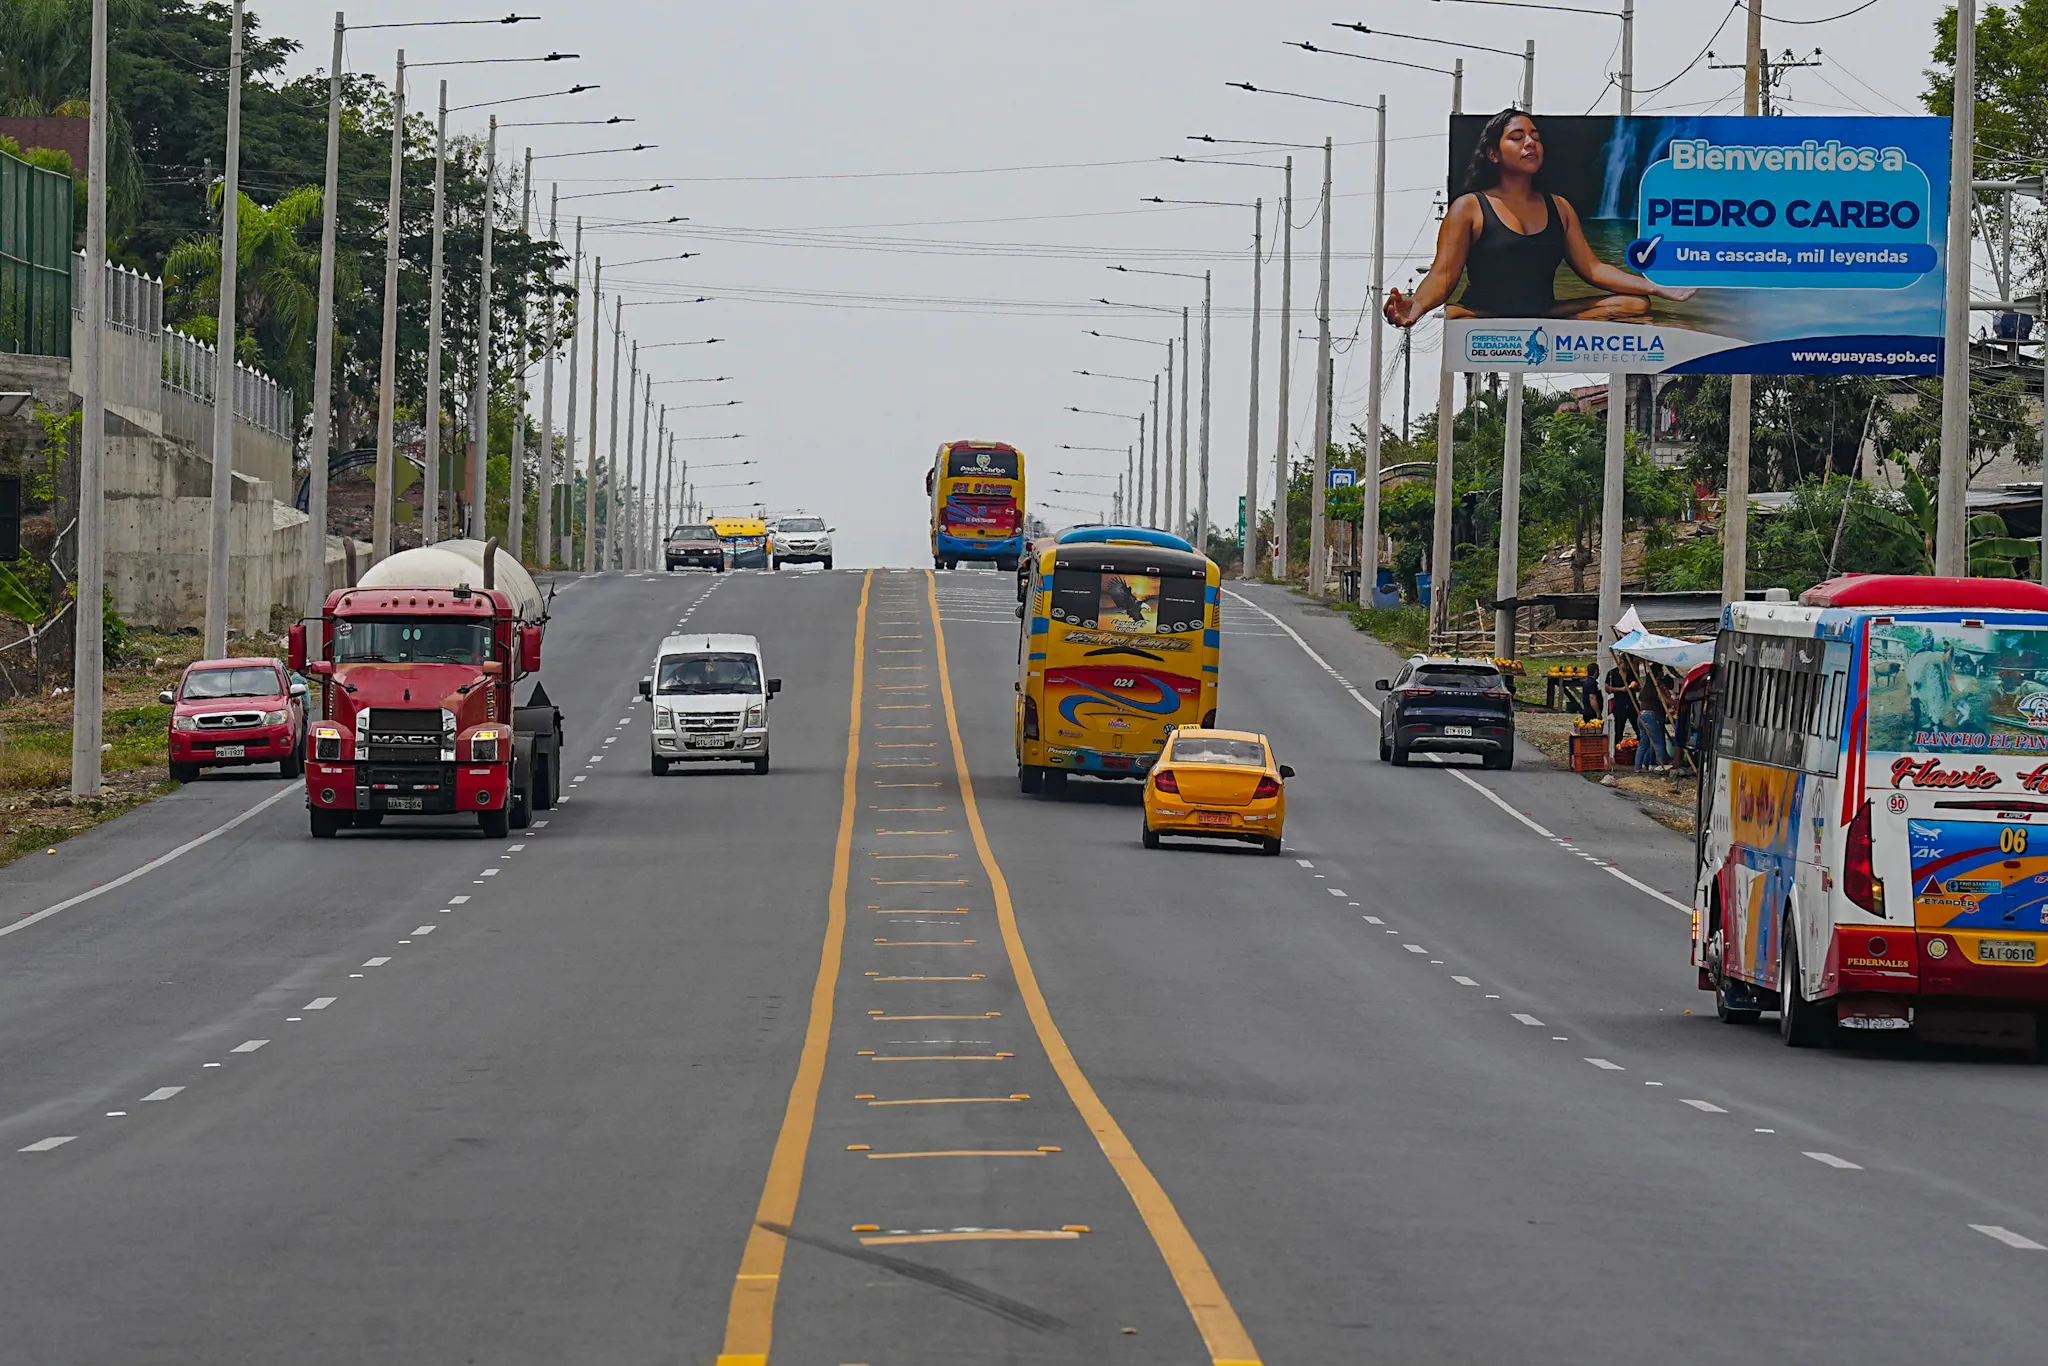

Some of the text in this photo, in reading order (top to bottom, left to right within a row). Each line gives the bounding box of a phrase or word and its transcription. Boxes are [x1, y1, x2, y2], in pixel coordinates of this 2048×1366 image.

[1672, 142, 1903, 171] Bienvenidos a
[1647, 198, 1920, 229] PEDRO CARBO
[1676, 247, 1908, 265] Una cascada, mil leyendas
[1555, 335, 1665, 351] MARCELA
[1573, 353, 1648, 362] PREFECTA
[1791, 351, 1937, 364] www.guayas.gob.ec
[1113, 678, 1135, 688] 024
[372, 735, 438, 744] MACK
[1915, 732, 2048, 749] RANCHO EL PAN
[1890, 756, 2002, 789] Flavio
[1890, 798, 1905, 810] 90
[2000, 827, 2028, 853] 06
[1847, 957, 1909, 968] PEDERNALES
